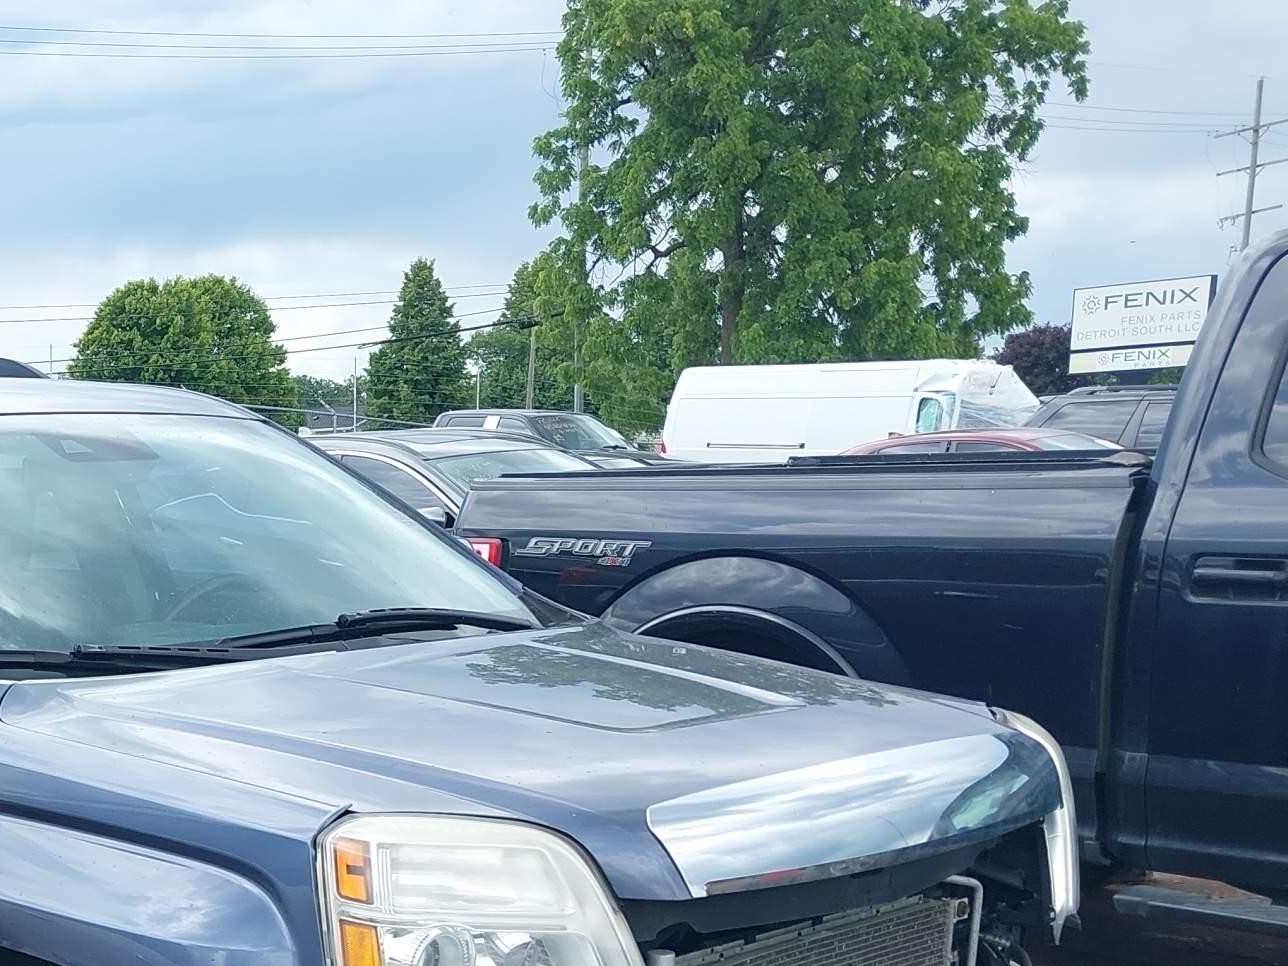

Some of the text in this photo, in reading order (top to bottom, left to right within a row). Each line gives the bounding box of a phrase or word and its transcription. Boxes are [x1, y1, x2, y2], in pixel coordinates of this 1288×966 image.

[1104, 287, 1200, 310] FENIX
[1120, 310, 1201, 326] FENIX PARTS
[1076, 321, 1200, 341] DETROIT SOUTH LLC
[1111, 348, 1171, 363] FENIX
[514, 536, 652, 557] SPORT
